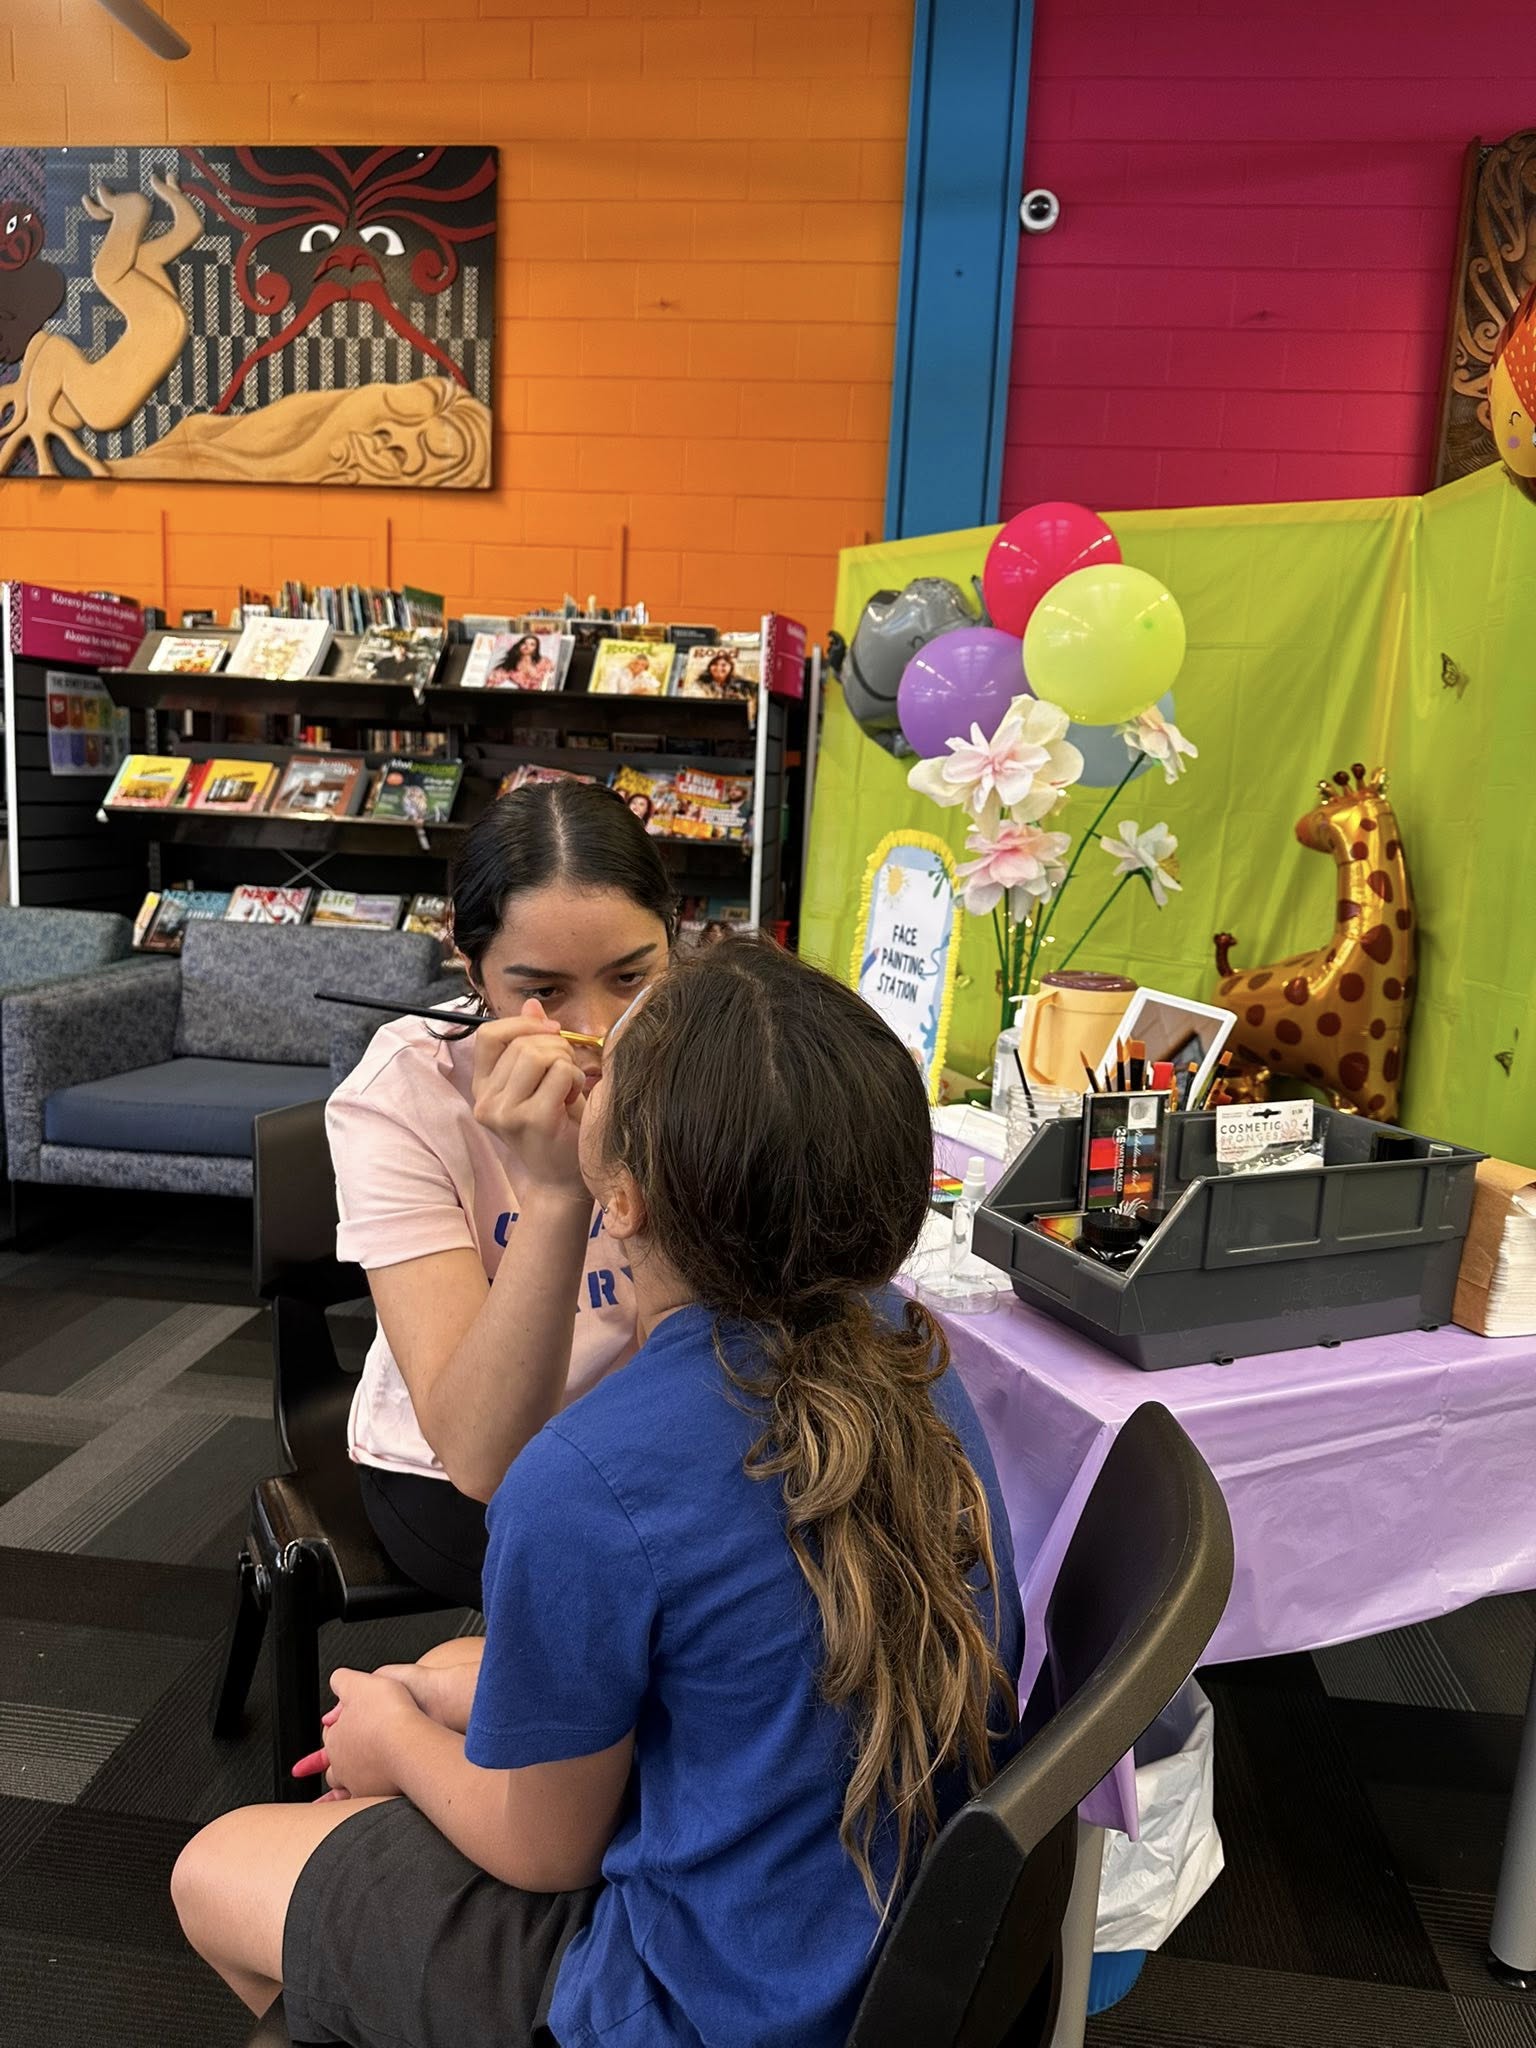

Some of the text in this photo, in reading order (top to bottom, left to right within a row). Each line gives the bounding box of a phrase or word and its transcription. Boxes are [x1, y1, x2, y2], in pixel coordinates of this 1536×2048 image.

[693, 648, 739, 659] good
[892, 924, 917, 946] FACE
[881, 947, 925, 976] PAINTING
[877, 973, 919, 1004] STATION
[1220, 1121, 1281, 1135] COSMETIC
[1302, 1118, 1309, 1130] 4
[1220, 1132, 1278, 1147] SPONGES
[1118, 1143, 1126, 1167] WATER
[1116, 1168, 1124, 1192] BASED
